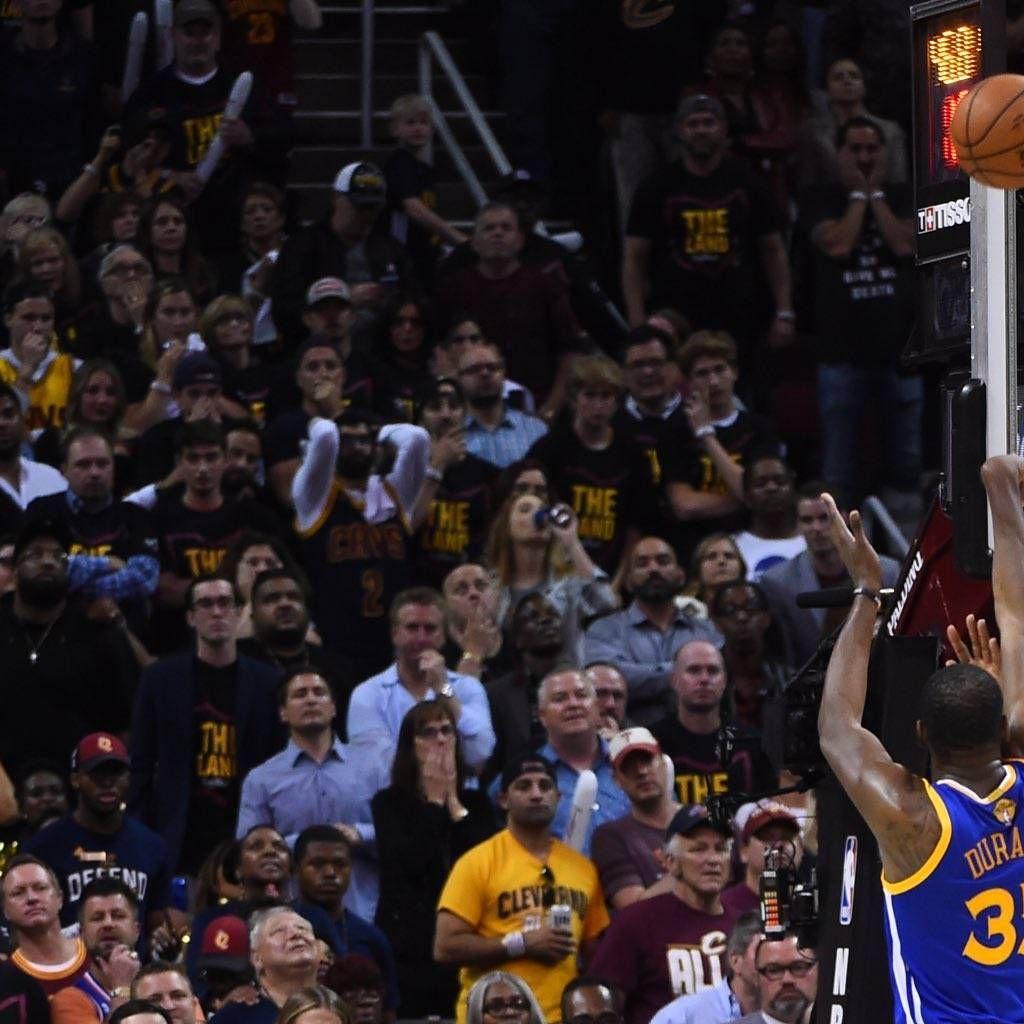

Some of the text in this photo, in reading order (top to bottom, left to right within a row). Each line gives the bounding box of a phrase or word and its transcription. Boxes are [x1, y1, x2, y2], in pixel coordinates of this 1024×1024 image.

[680, 208, 729, 234] THE
[571, 484, 619, 518] THE
[360, 569, 385, 618] 2
[196, 754, 238, 778] LAN
